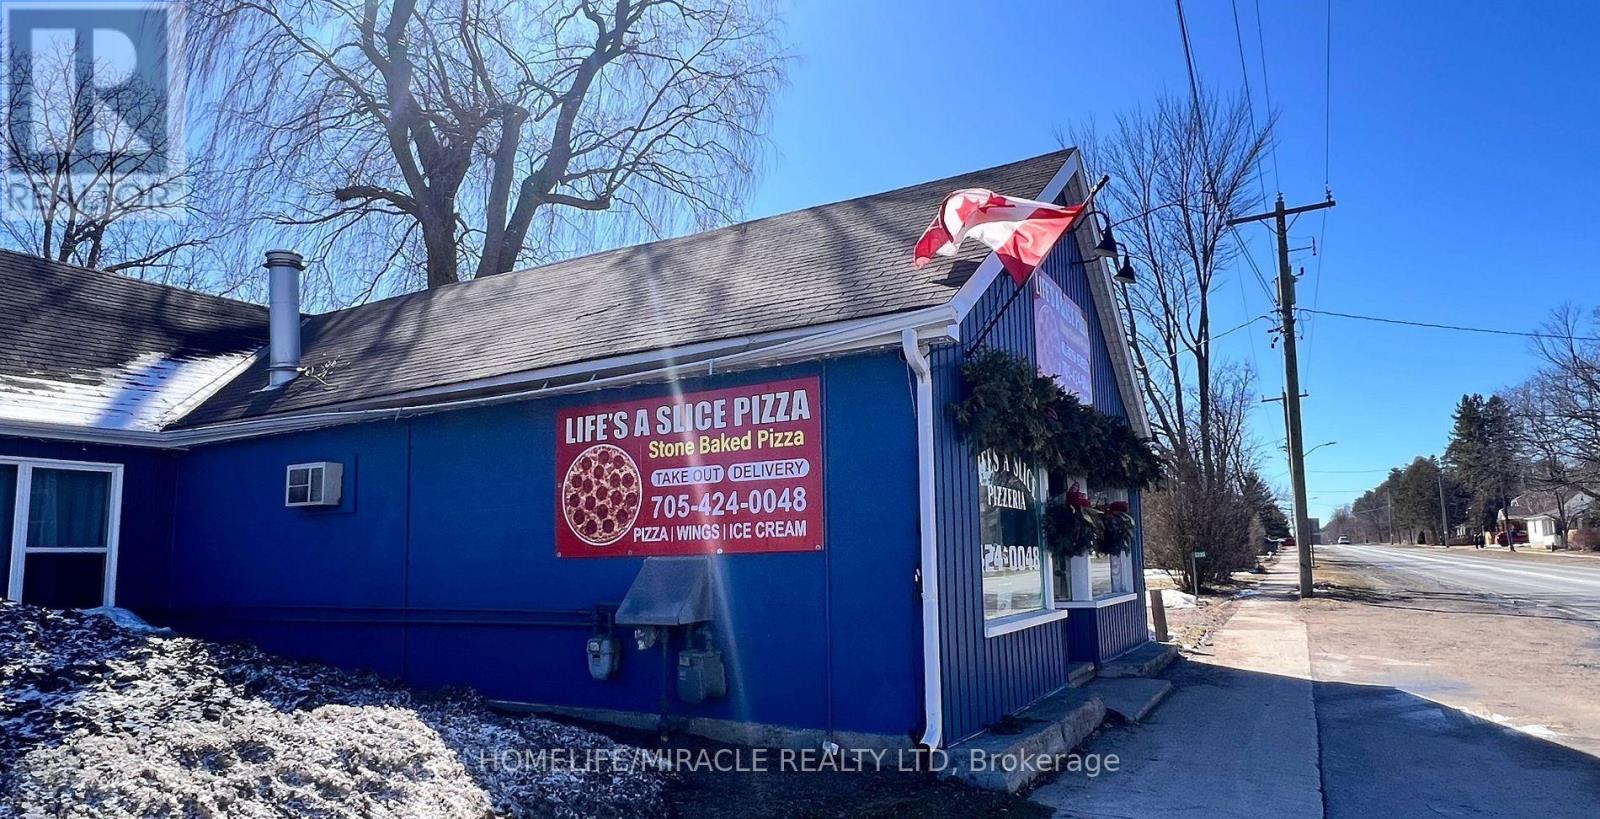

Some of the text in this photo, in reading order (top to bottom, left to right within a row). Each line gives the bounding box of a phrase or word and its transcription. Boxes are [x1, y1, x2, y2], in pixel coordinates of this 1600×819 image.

[565, 389, 811, 444] LIFE'S A SLICE PIZZA
[648, 429, 804, 459] Stone Baked Pizza
[733, 461, 804, 479] DELIVERY
[1003, 453, 1010, 472] A
[655, 467, 721, 484] TAKE OUT
[651, 486, 807, 519] 705-424-0048
[987, 485, 1027, 511] PIZZERIA
[633, 520, 807, 543] PIZZA WINGS ICE CREAM
